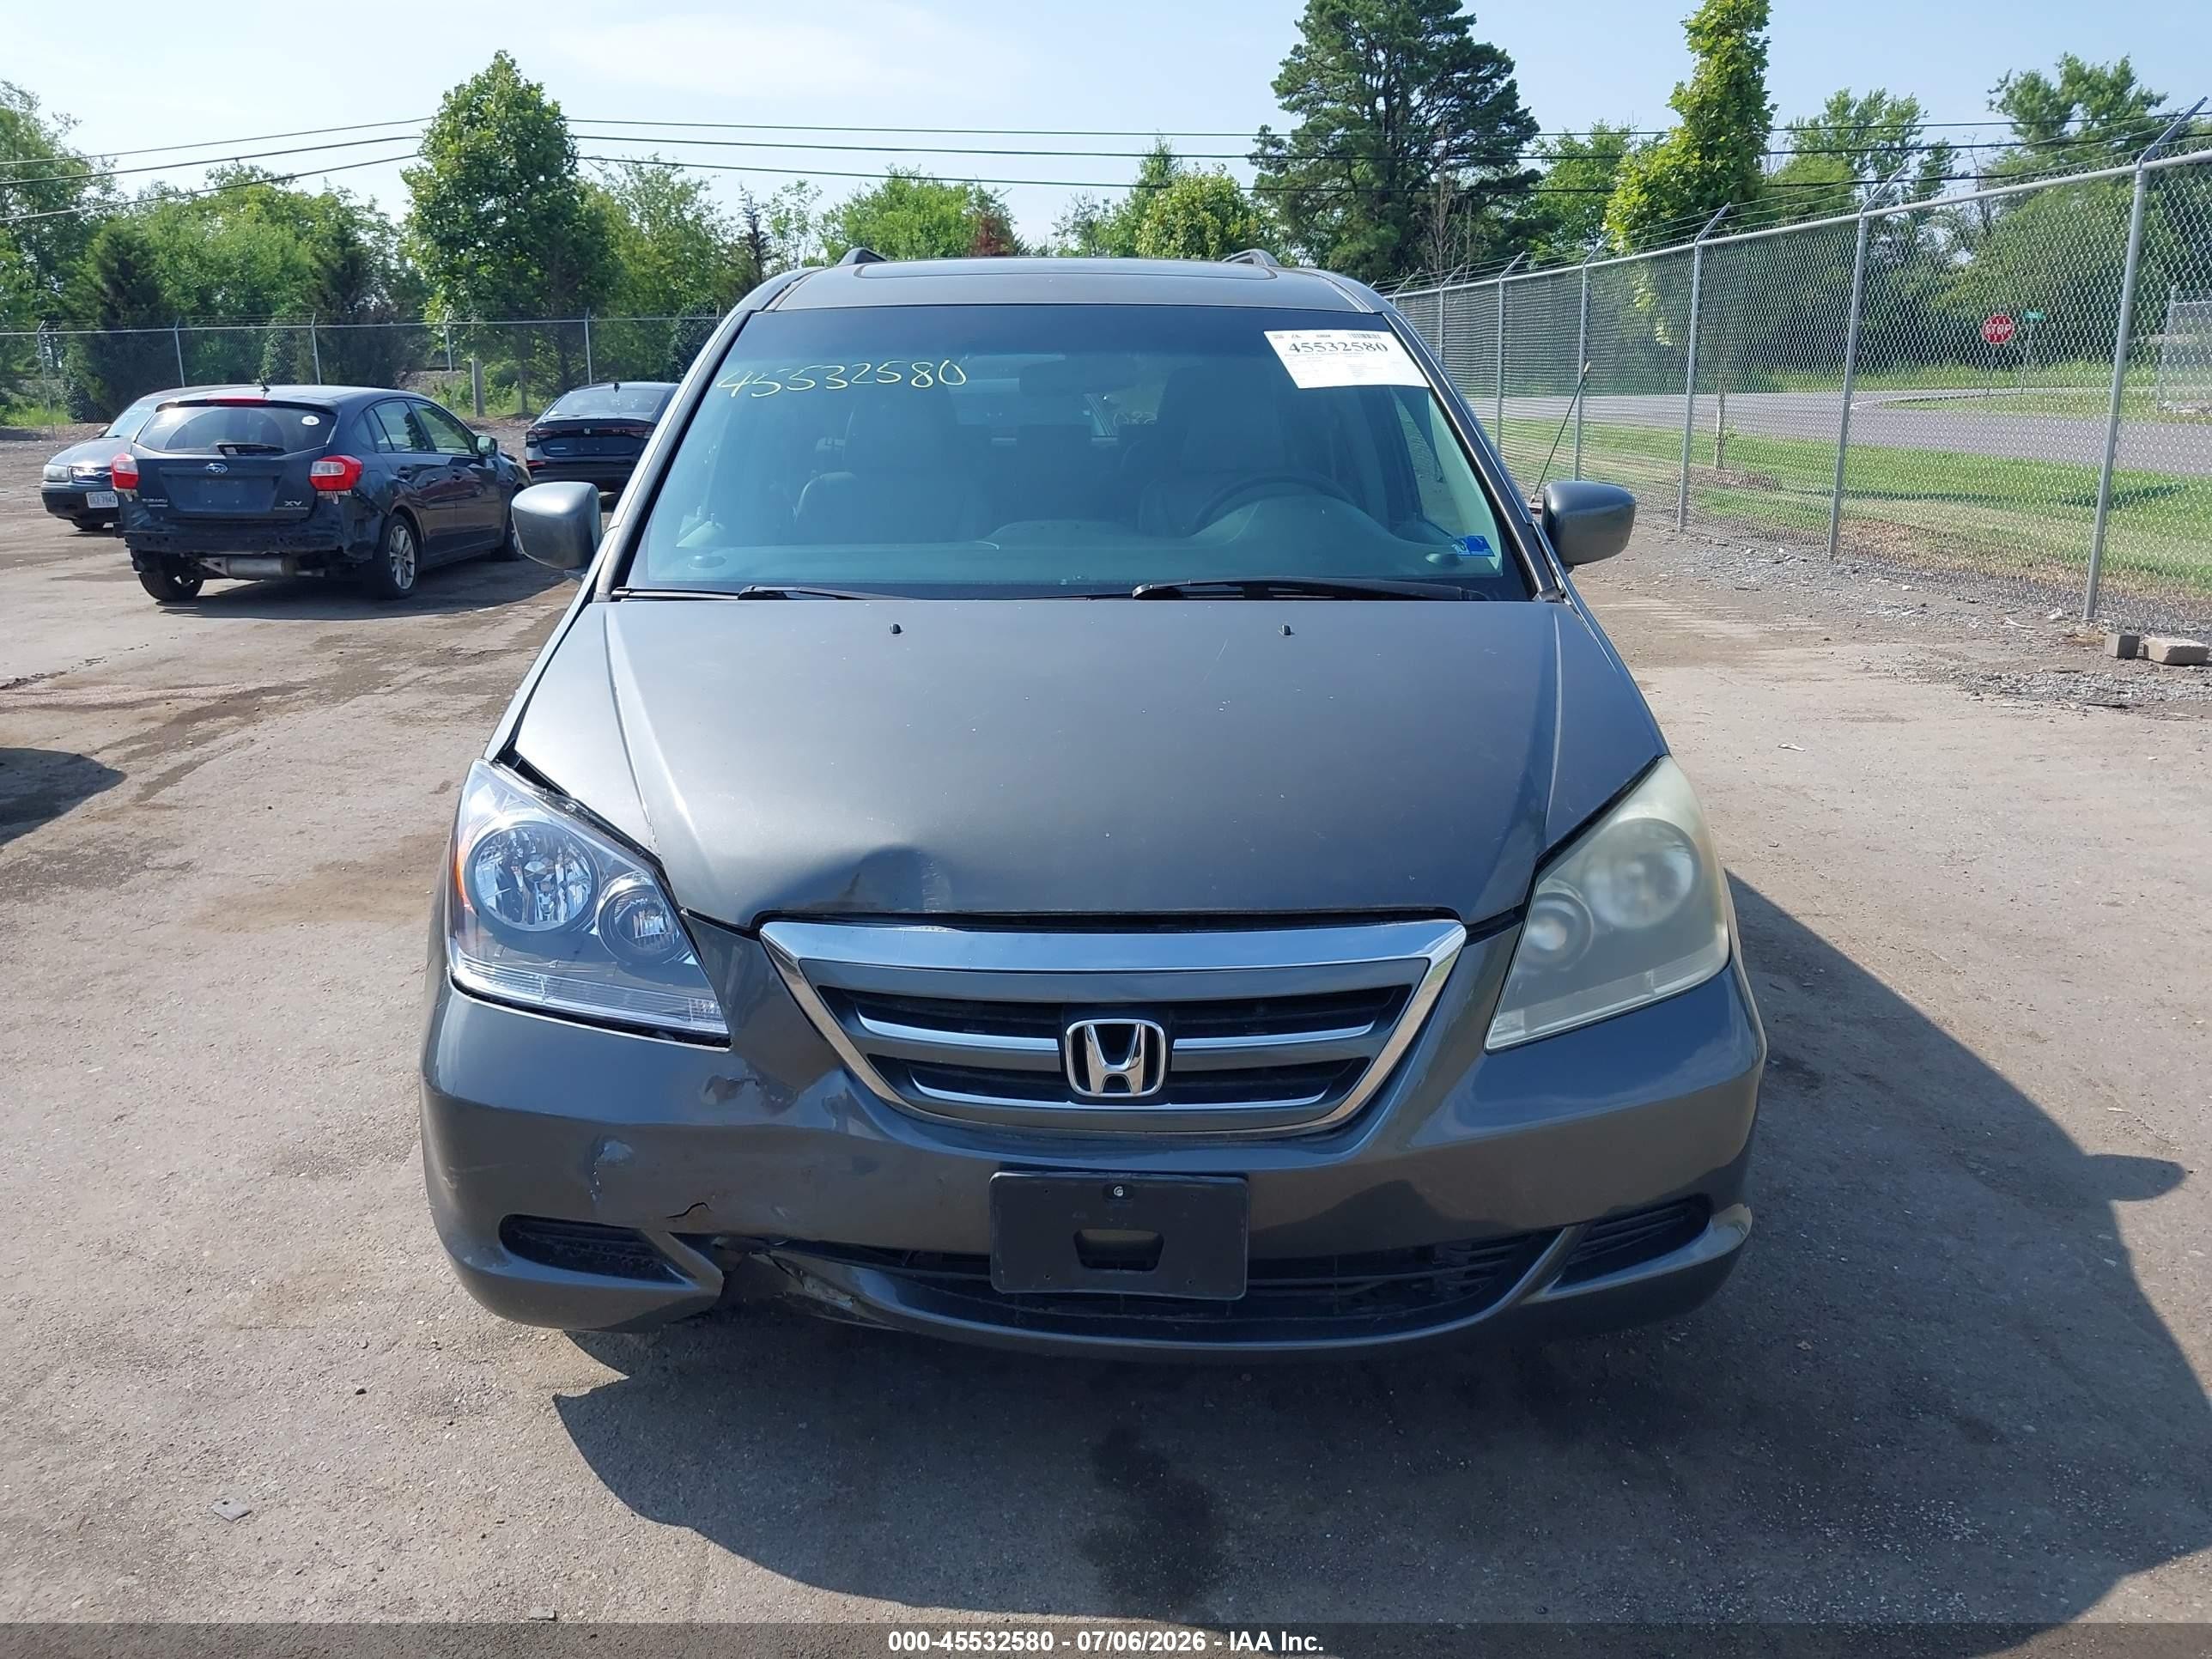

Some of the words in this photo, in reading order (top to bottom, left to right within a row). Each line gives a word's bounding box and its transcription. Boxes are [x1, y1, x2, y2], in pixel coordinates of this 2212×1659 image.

[1985, 325, 2012, 334] STOP
[1289, 342, 1389, 353] 45532580
[716, 359, 968, 398] 45532580
